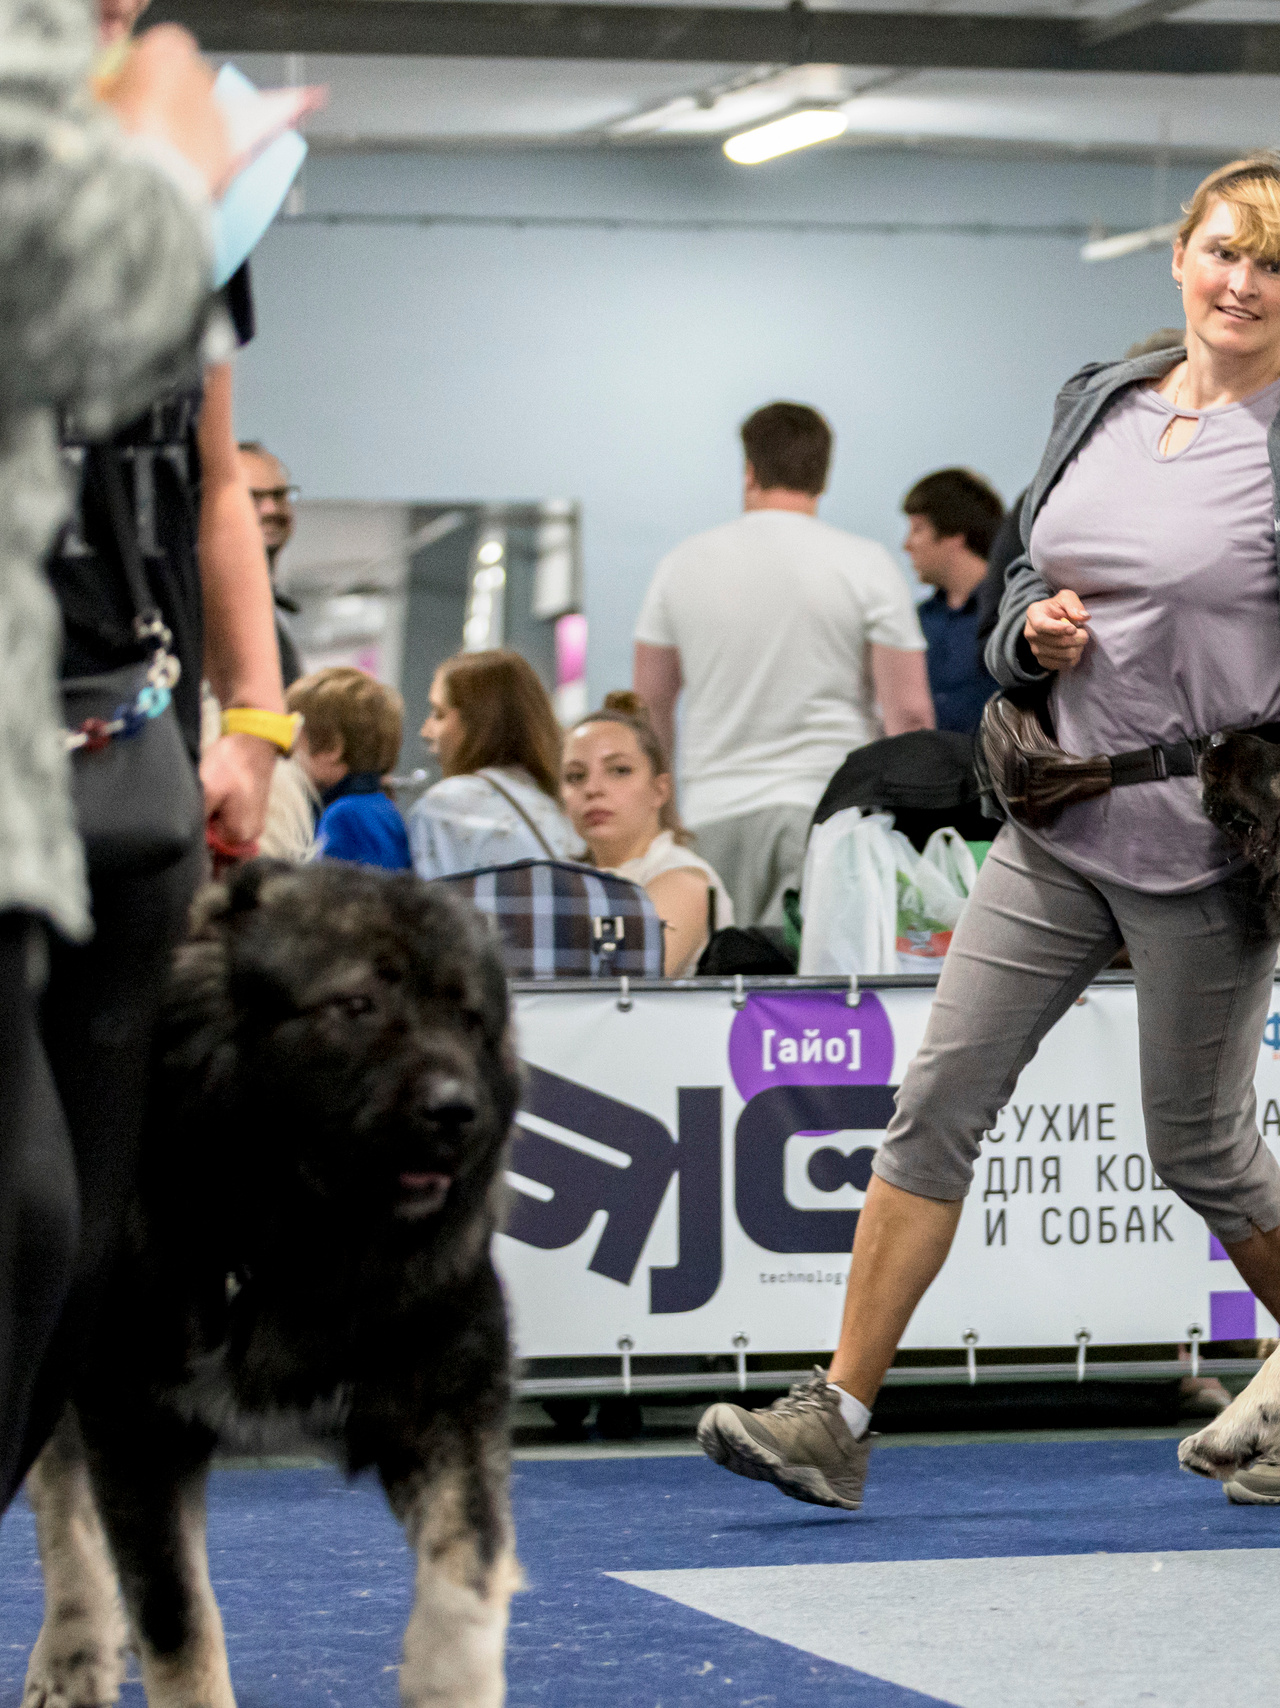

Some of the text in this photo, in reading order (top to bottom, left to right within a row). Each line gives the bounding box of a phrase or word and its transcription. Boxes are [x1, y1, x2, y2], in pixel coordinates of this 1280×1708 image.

[761, 1028, 862, 1071] [айо]
[982, 1154, 1061, 1202] ДЛЯ
[984, 1204, 1175, 1246] И СОБАК
